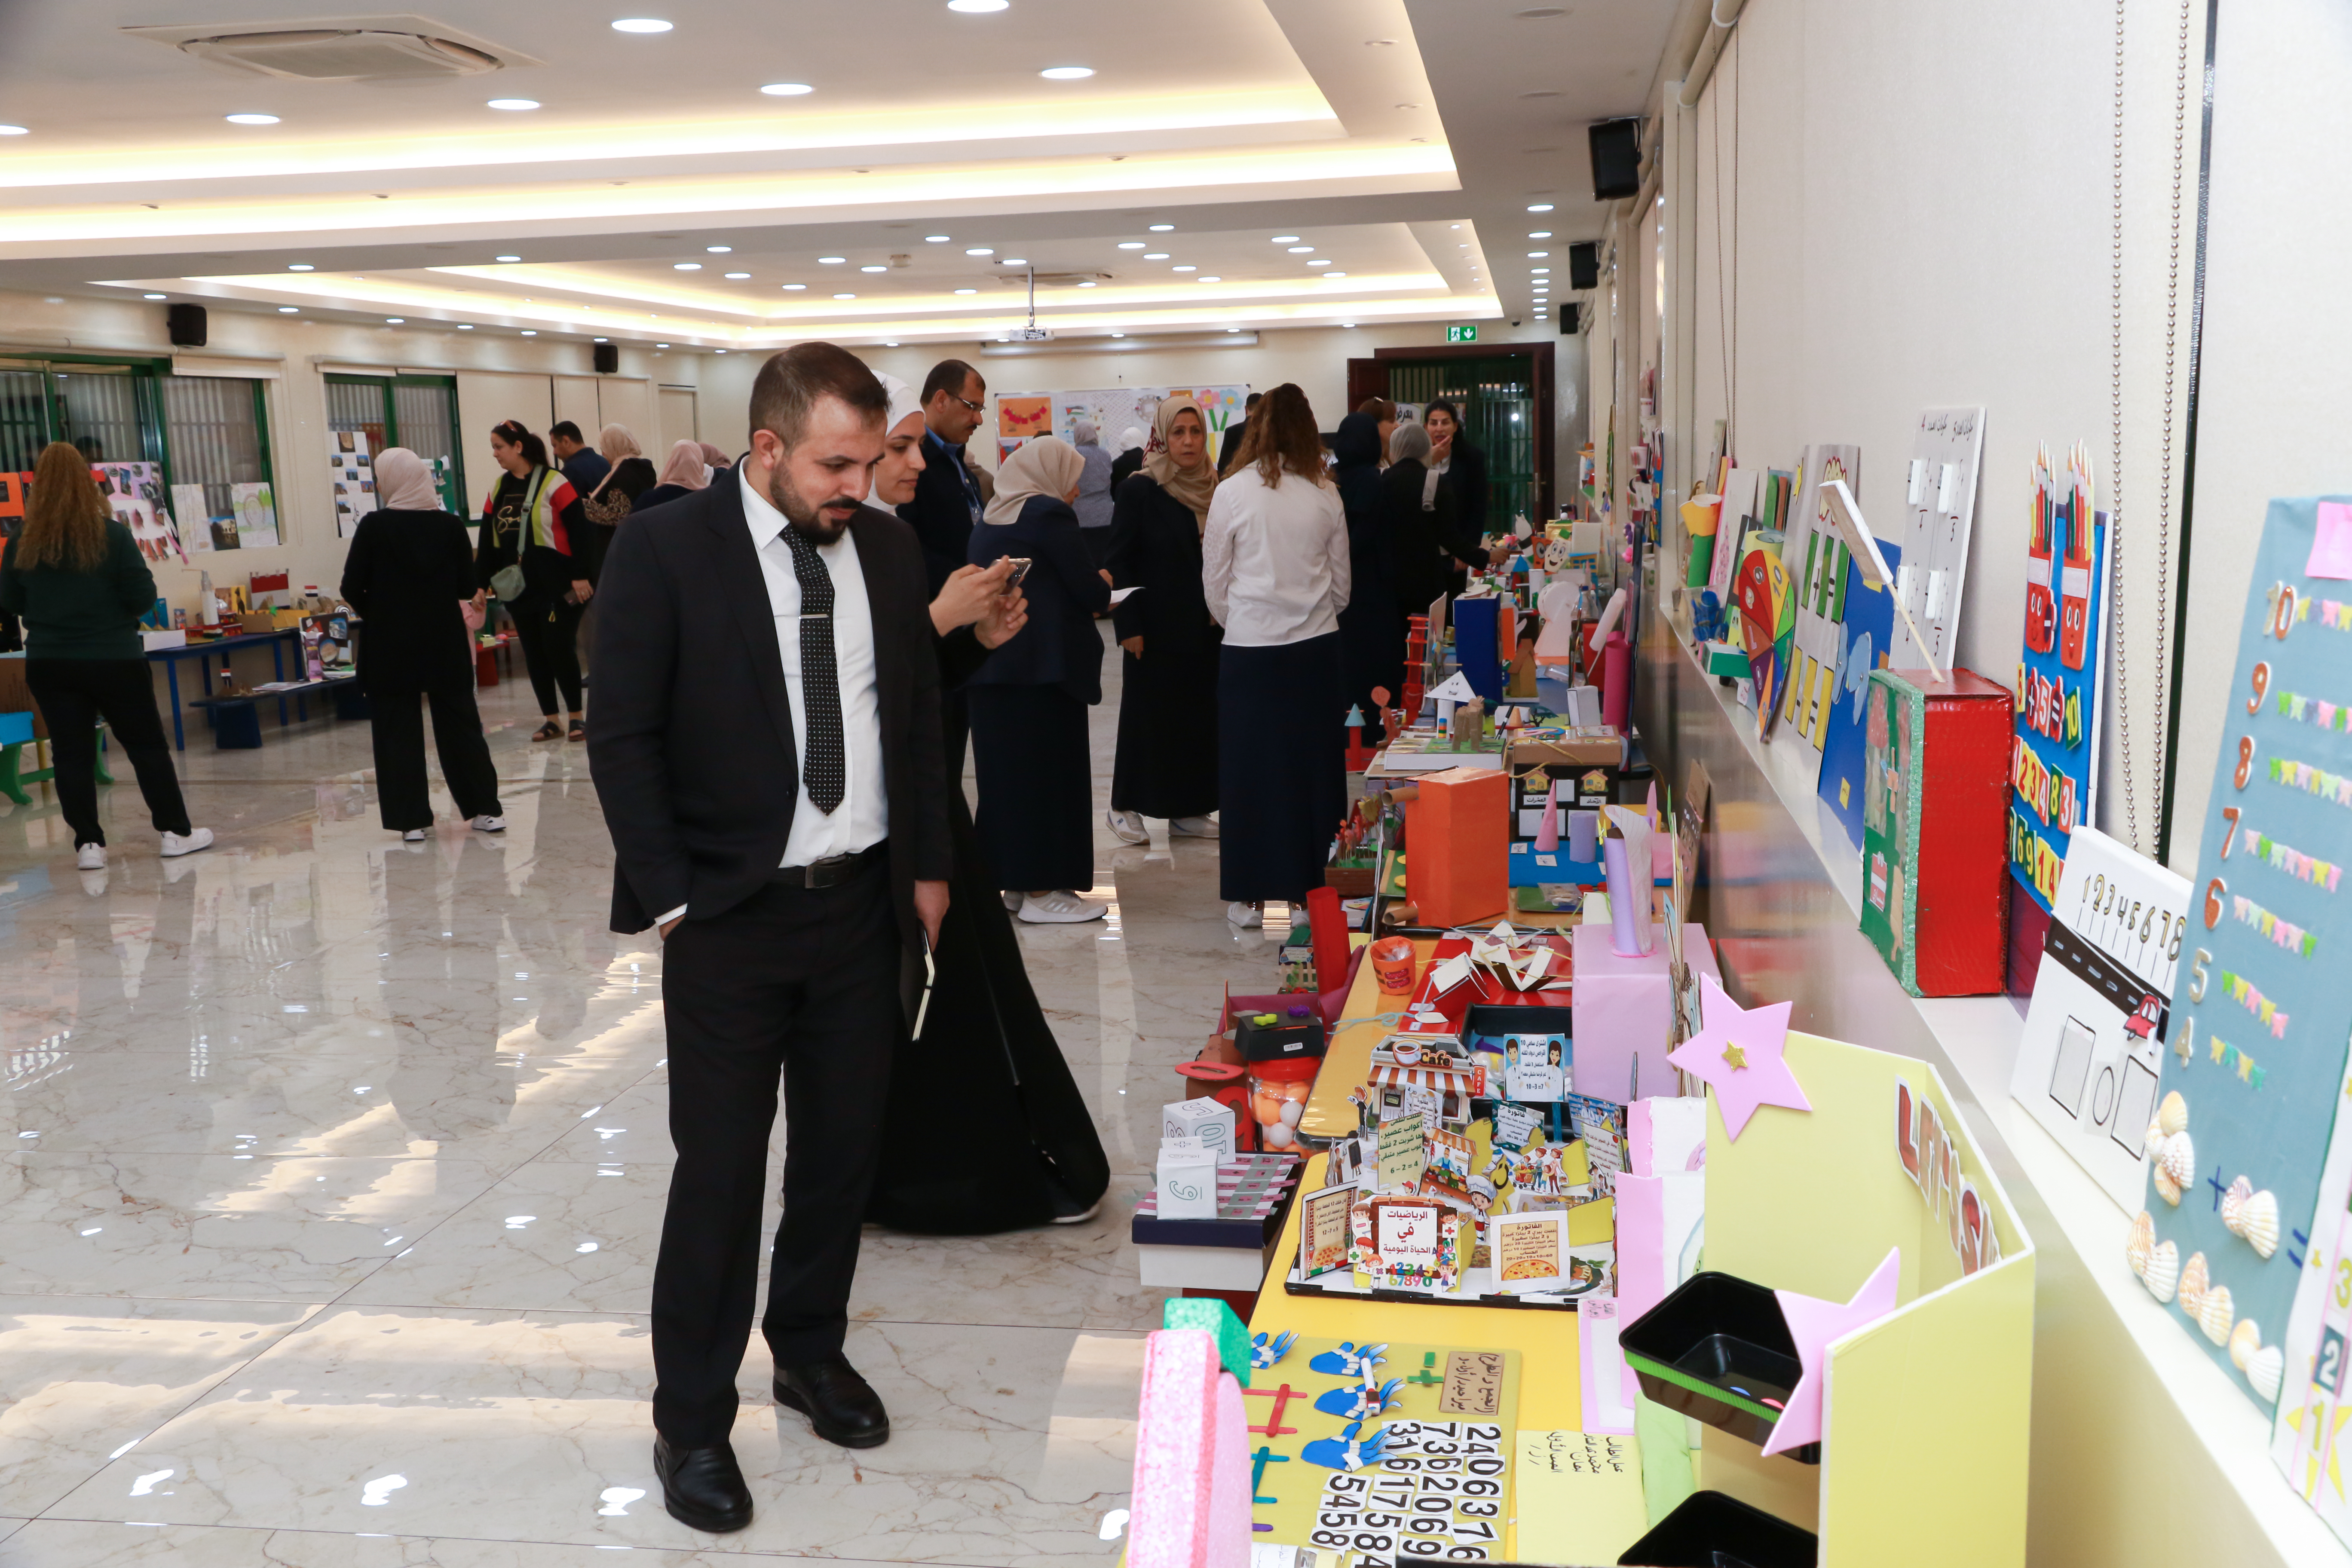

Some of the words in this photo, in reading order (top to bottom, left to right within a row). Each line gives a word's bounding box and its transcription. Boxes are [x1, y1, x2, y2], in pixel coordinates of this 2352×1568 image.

[2263, 580, 2298, 640] 10
[2018, 668, 2022, 706] 5
[2039, 685, 2048, 725] 5
[2066, 695, 2078, 741] 10
[2247, 661, 2271, 715] 9
[2234, 735, 2255, 790] 8
[2051, 775, 2059, 815] 8
[2061, 784, 2070, 827] 3
[2026, 837, 2034, 876] 9
[2220, 807, 2242, 859] 7
[2082, 874, 2091, 903] 1
[2093, 874, 2104, 912] 2
[2104, 884, 2115, 916] 3
[2117, 896, 2128, 926] 4
[2128, 901, 2141, 930] 5
[2139, 906, 2156, 944] 6
[2160, 910, 2171, 949] 7
[2168, 916, 2186, 962] 8
[2204, 877, 2227, 931] 6
[2188, 948, 2213, 1003] 5
[1421, 1052, 1451, 1066] Cafe
[2174, 1016, 2194, 1069] 4
[1379, 1141, 1391, 1150] فقط
[1396, 1148, 1409, 1157] عصير
[1399, 1134, 1414, 1145] شربت
[1411, 1143, 1421, 1152] كوب
[1387, 1210, 1428, 1221] الرياضيات
[1397, 1222, 1414, 1243] في
[1383, 1243, 1408, 1254] اليومية
[1410, 1245, 1430, 1255] الحياة
[2319, 1338, 2341, 1387] 2
[2311, 1400, 2326, 1452] 1
